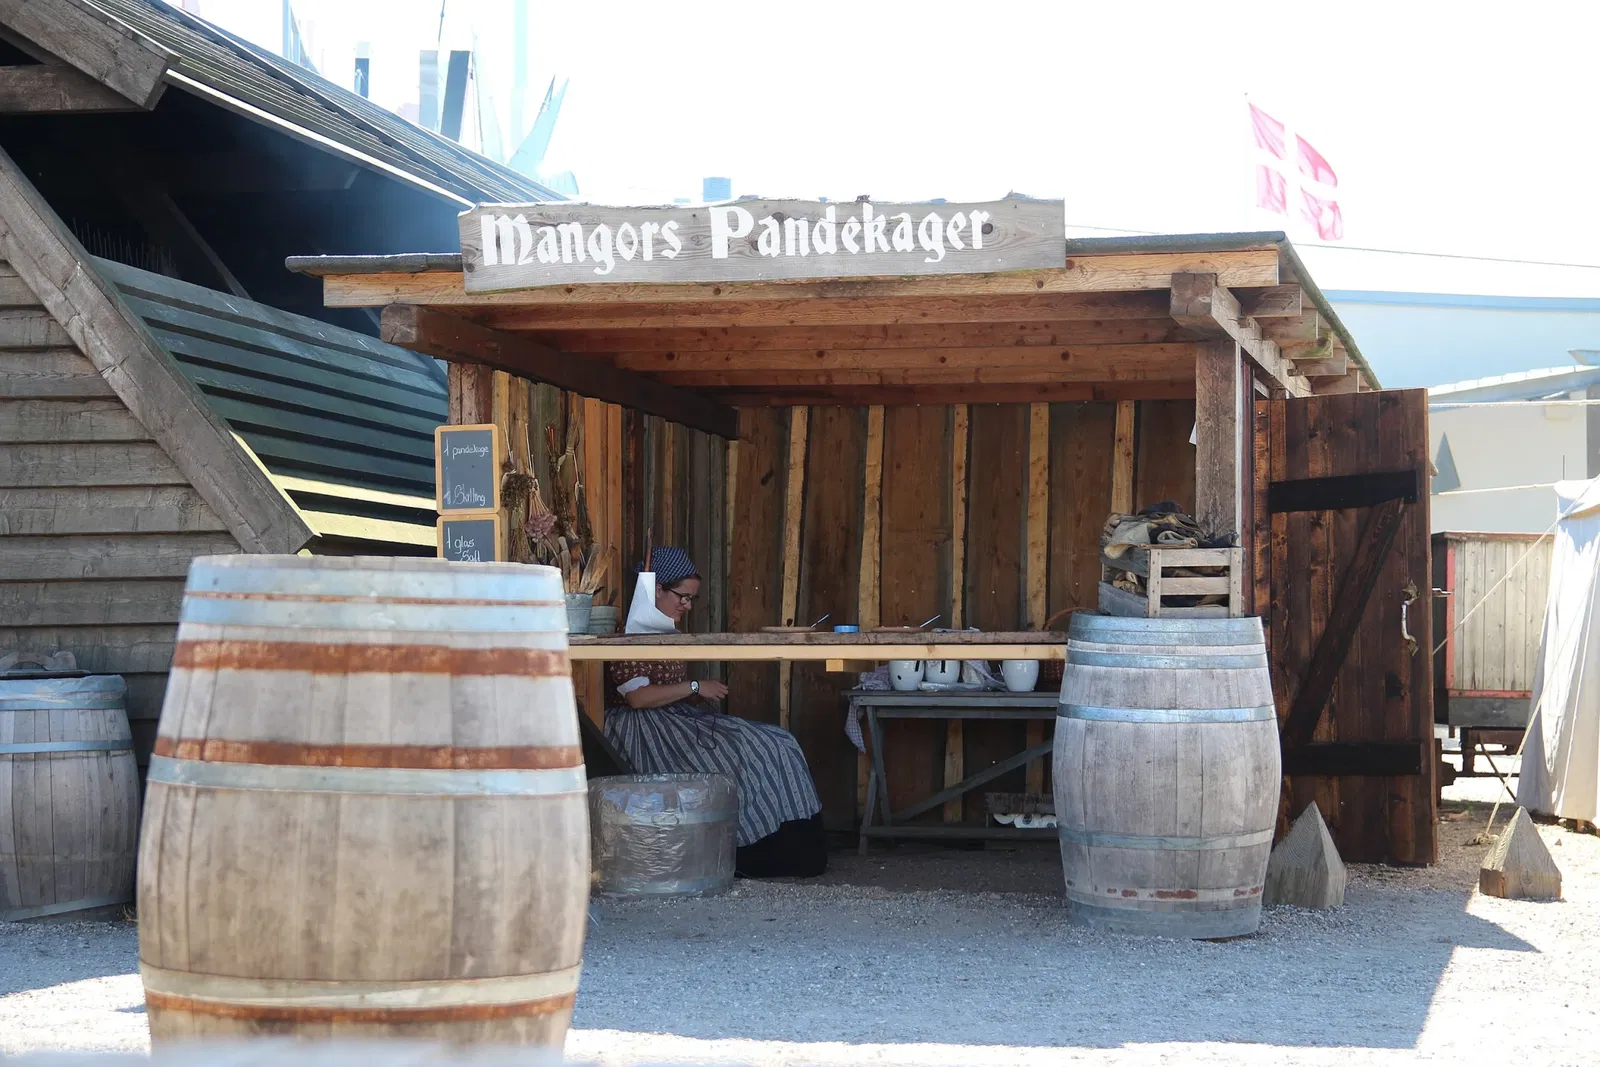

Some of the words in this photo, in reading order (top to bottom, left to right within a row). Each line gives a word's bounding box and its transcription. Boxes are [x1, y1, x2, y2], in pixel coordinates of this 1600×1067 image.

[480, 213, 682, 275] Mangors
[709, 202, 990, 263] Pandekager
[443, 436, 449, 456] 1
[446, 527, 451, 549] 1
[454, 535, 475, 554] glas
